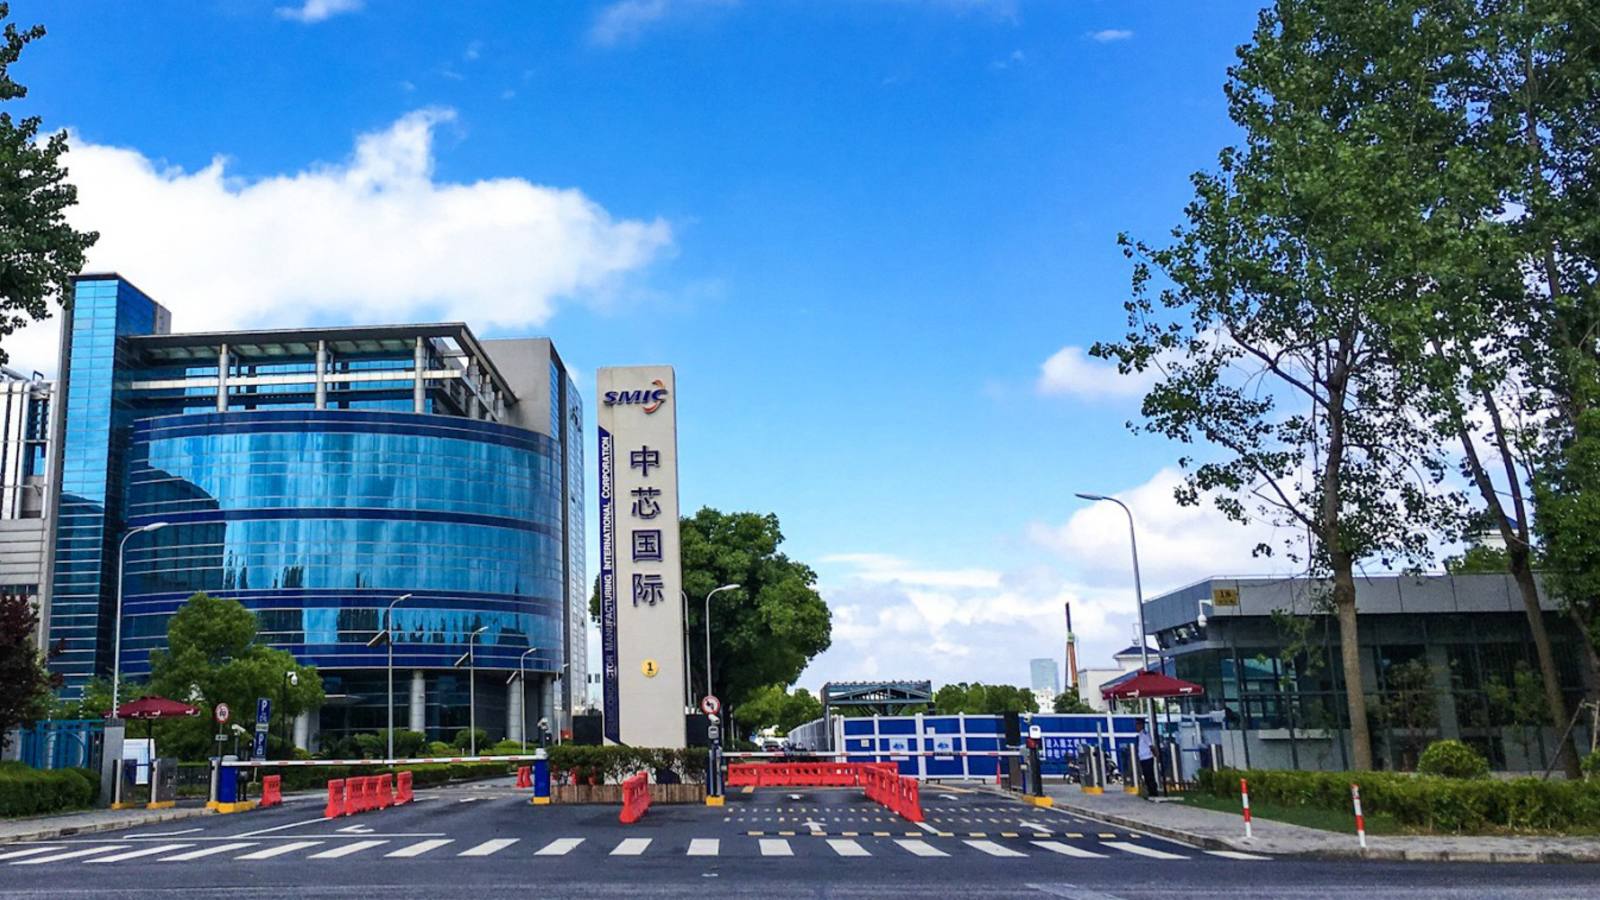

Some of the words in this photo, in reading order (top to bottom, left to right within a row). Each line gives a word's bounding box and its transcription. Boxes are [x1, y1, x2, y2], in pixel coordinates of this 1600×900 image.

[604, 388, 668, 406] SMIC
[601, 436, 611, 499] CORPORATION
[602, 502, 612, 570] INTERNATIONAL
[630, 445, 664, 606] 中芯国际
[603, 573, 614, 651] MANUFACTURING
[647, 661, 654, 671] 1
[261, 700, 268, 711] P
